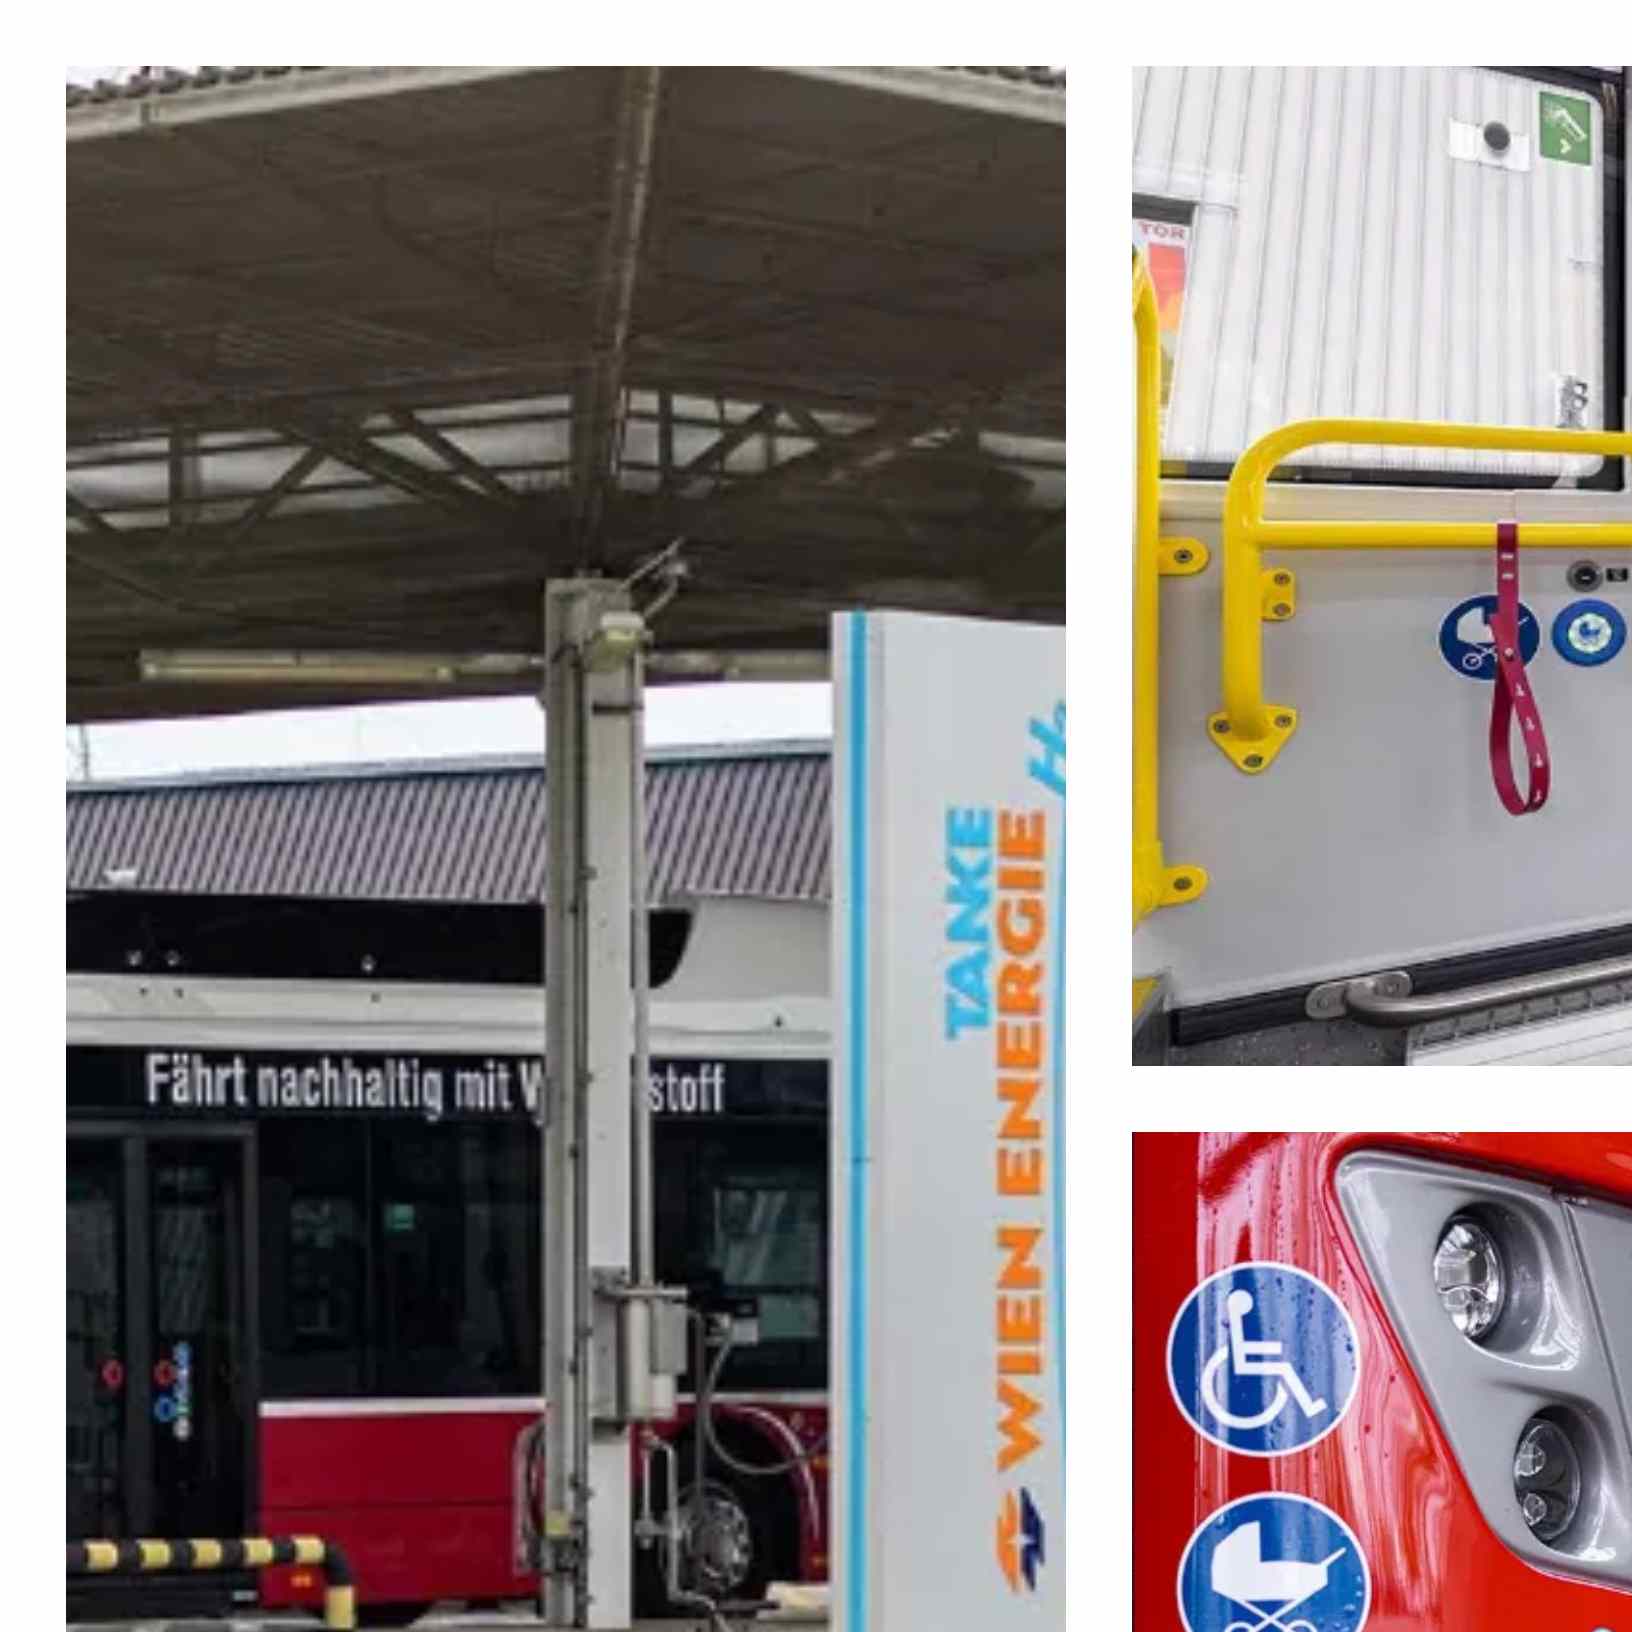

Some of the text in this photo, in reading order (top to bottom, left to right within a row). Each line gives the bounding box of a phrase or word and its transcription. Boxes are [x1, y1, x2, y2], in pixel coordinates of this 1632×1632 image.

[946, 808, 992, 1041] TANKE
[146, 1052, 247, 1105] Fährt
[256, 1056, 443, 1122] nachhaltig
[454, 1058, 513, 1111] mit
[996, 809, 1045, 1472] WIEN ENERGIE
